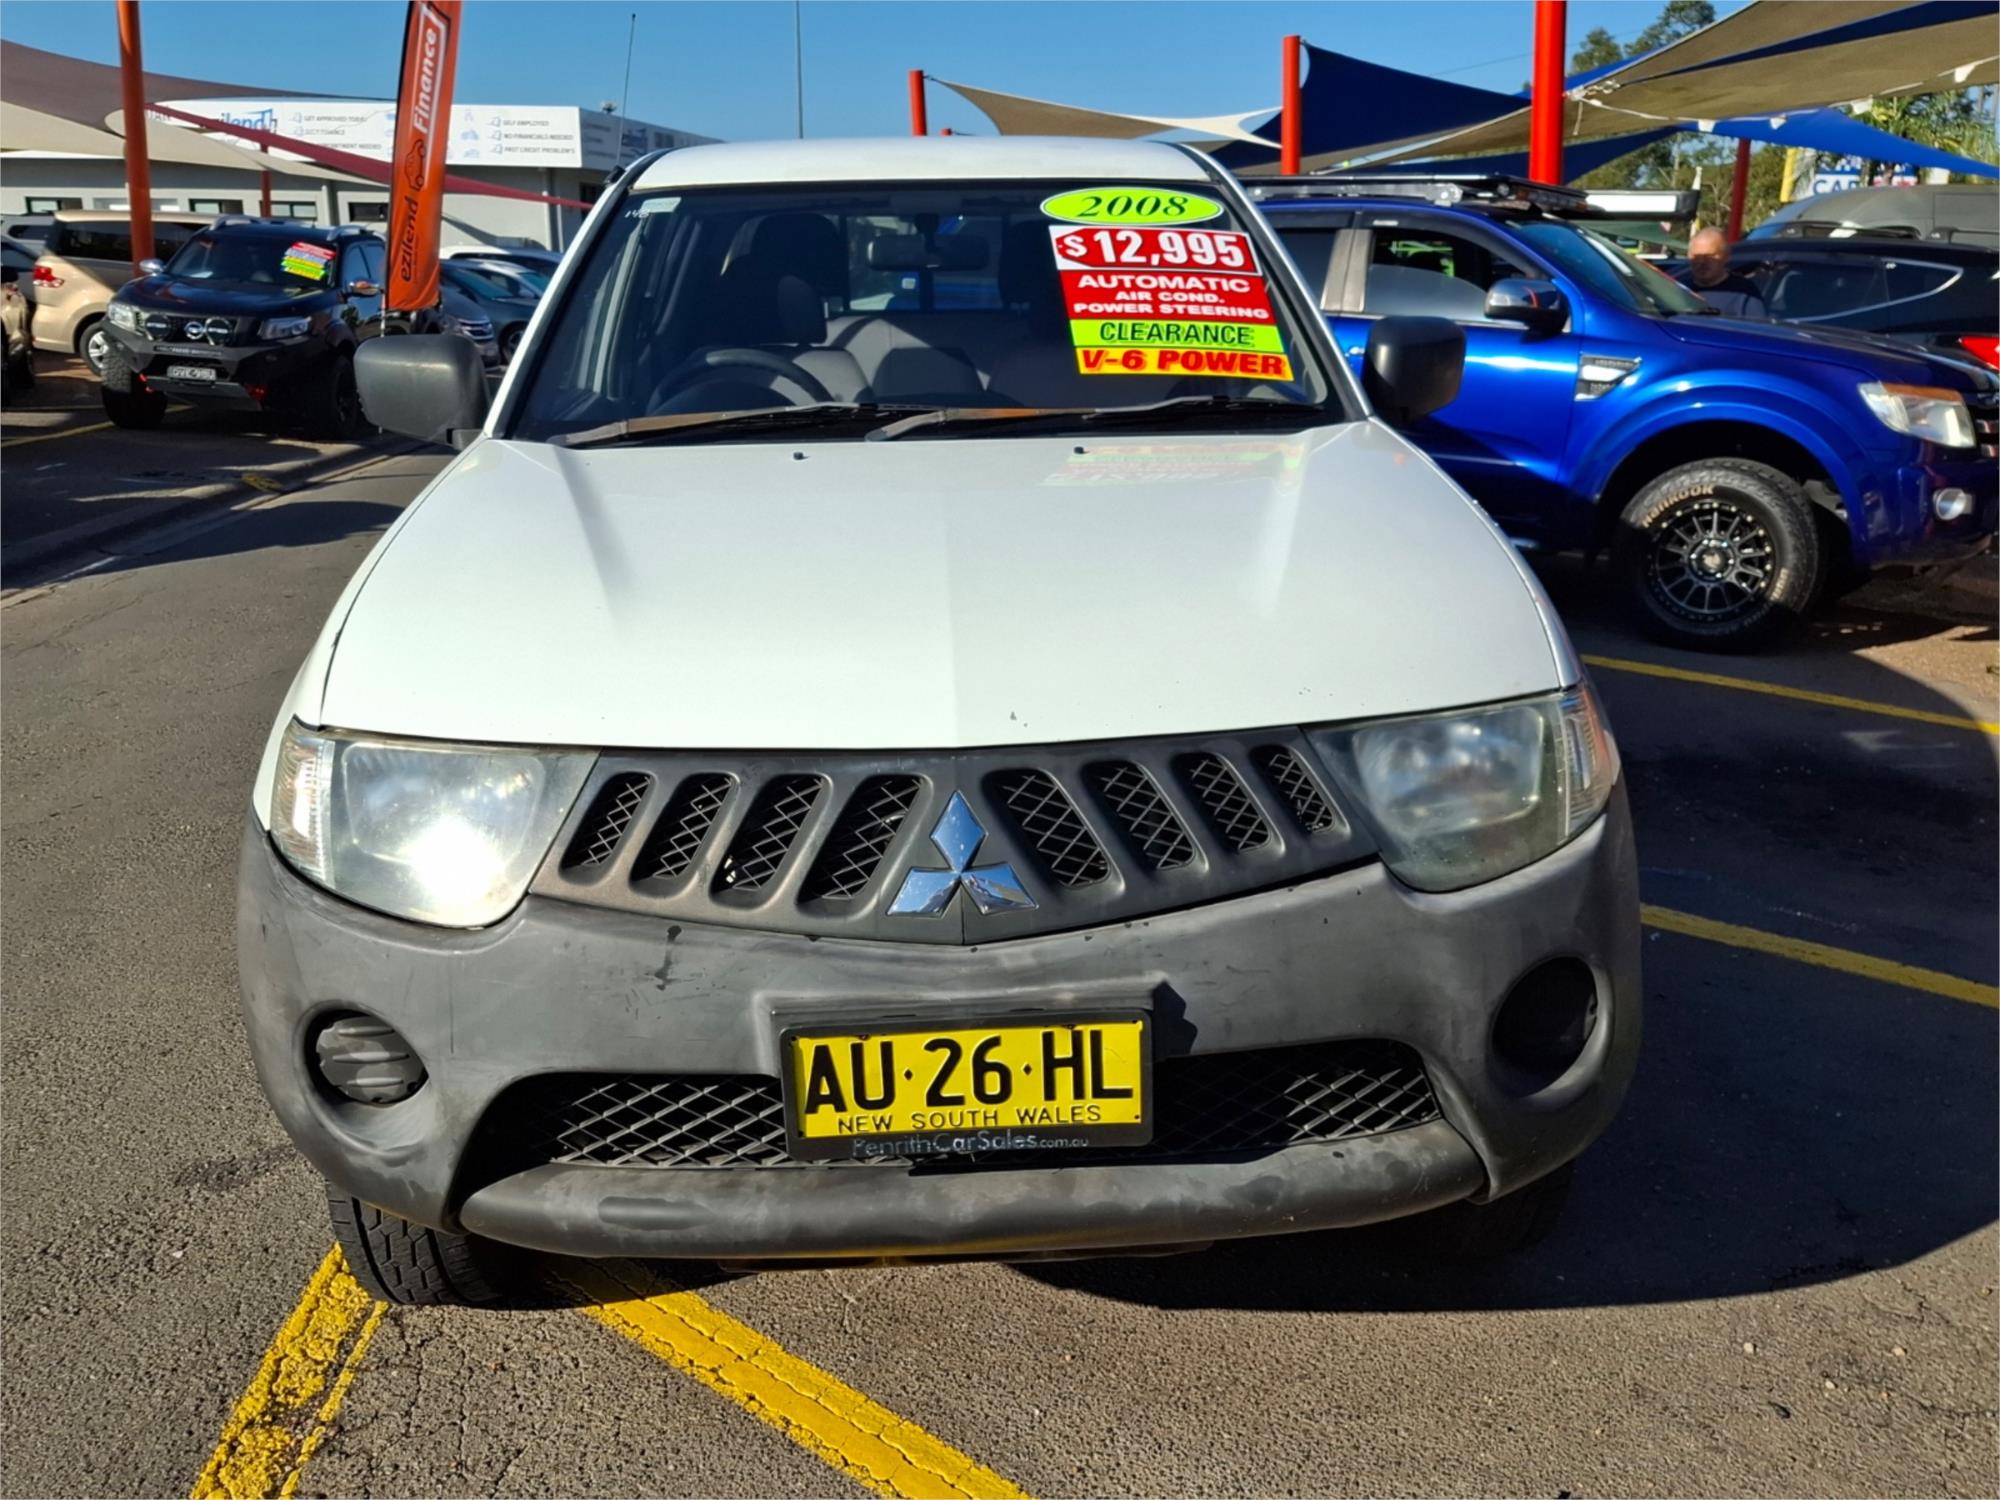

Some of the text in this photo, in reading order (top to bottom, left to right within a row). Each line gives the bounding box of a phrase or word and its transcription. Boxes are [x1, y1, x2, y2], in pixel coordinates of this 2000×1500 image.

[413, 28, 437, 134] Finance
[1076, 195, 1189, 217] 2008
[401, 195, 419, 283] ezilend
[1077, 274, 1251, 293] AUTOMATIC
[1115, 291, 1225, 304] AIR COND.
[1073, 302, 1269, 320] POWER STEERING
[1100, 322, 1252, 345] CLEARANCE
[1081, 350, 1285, 375] V-6 POWER
[838, 1104, 1102, 1134] NEW SOUTH WALES
